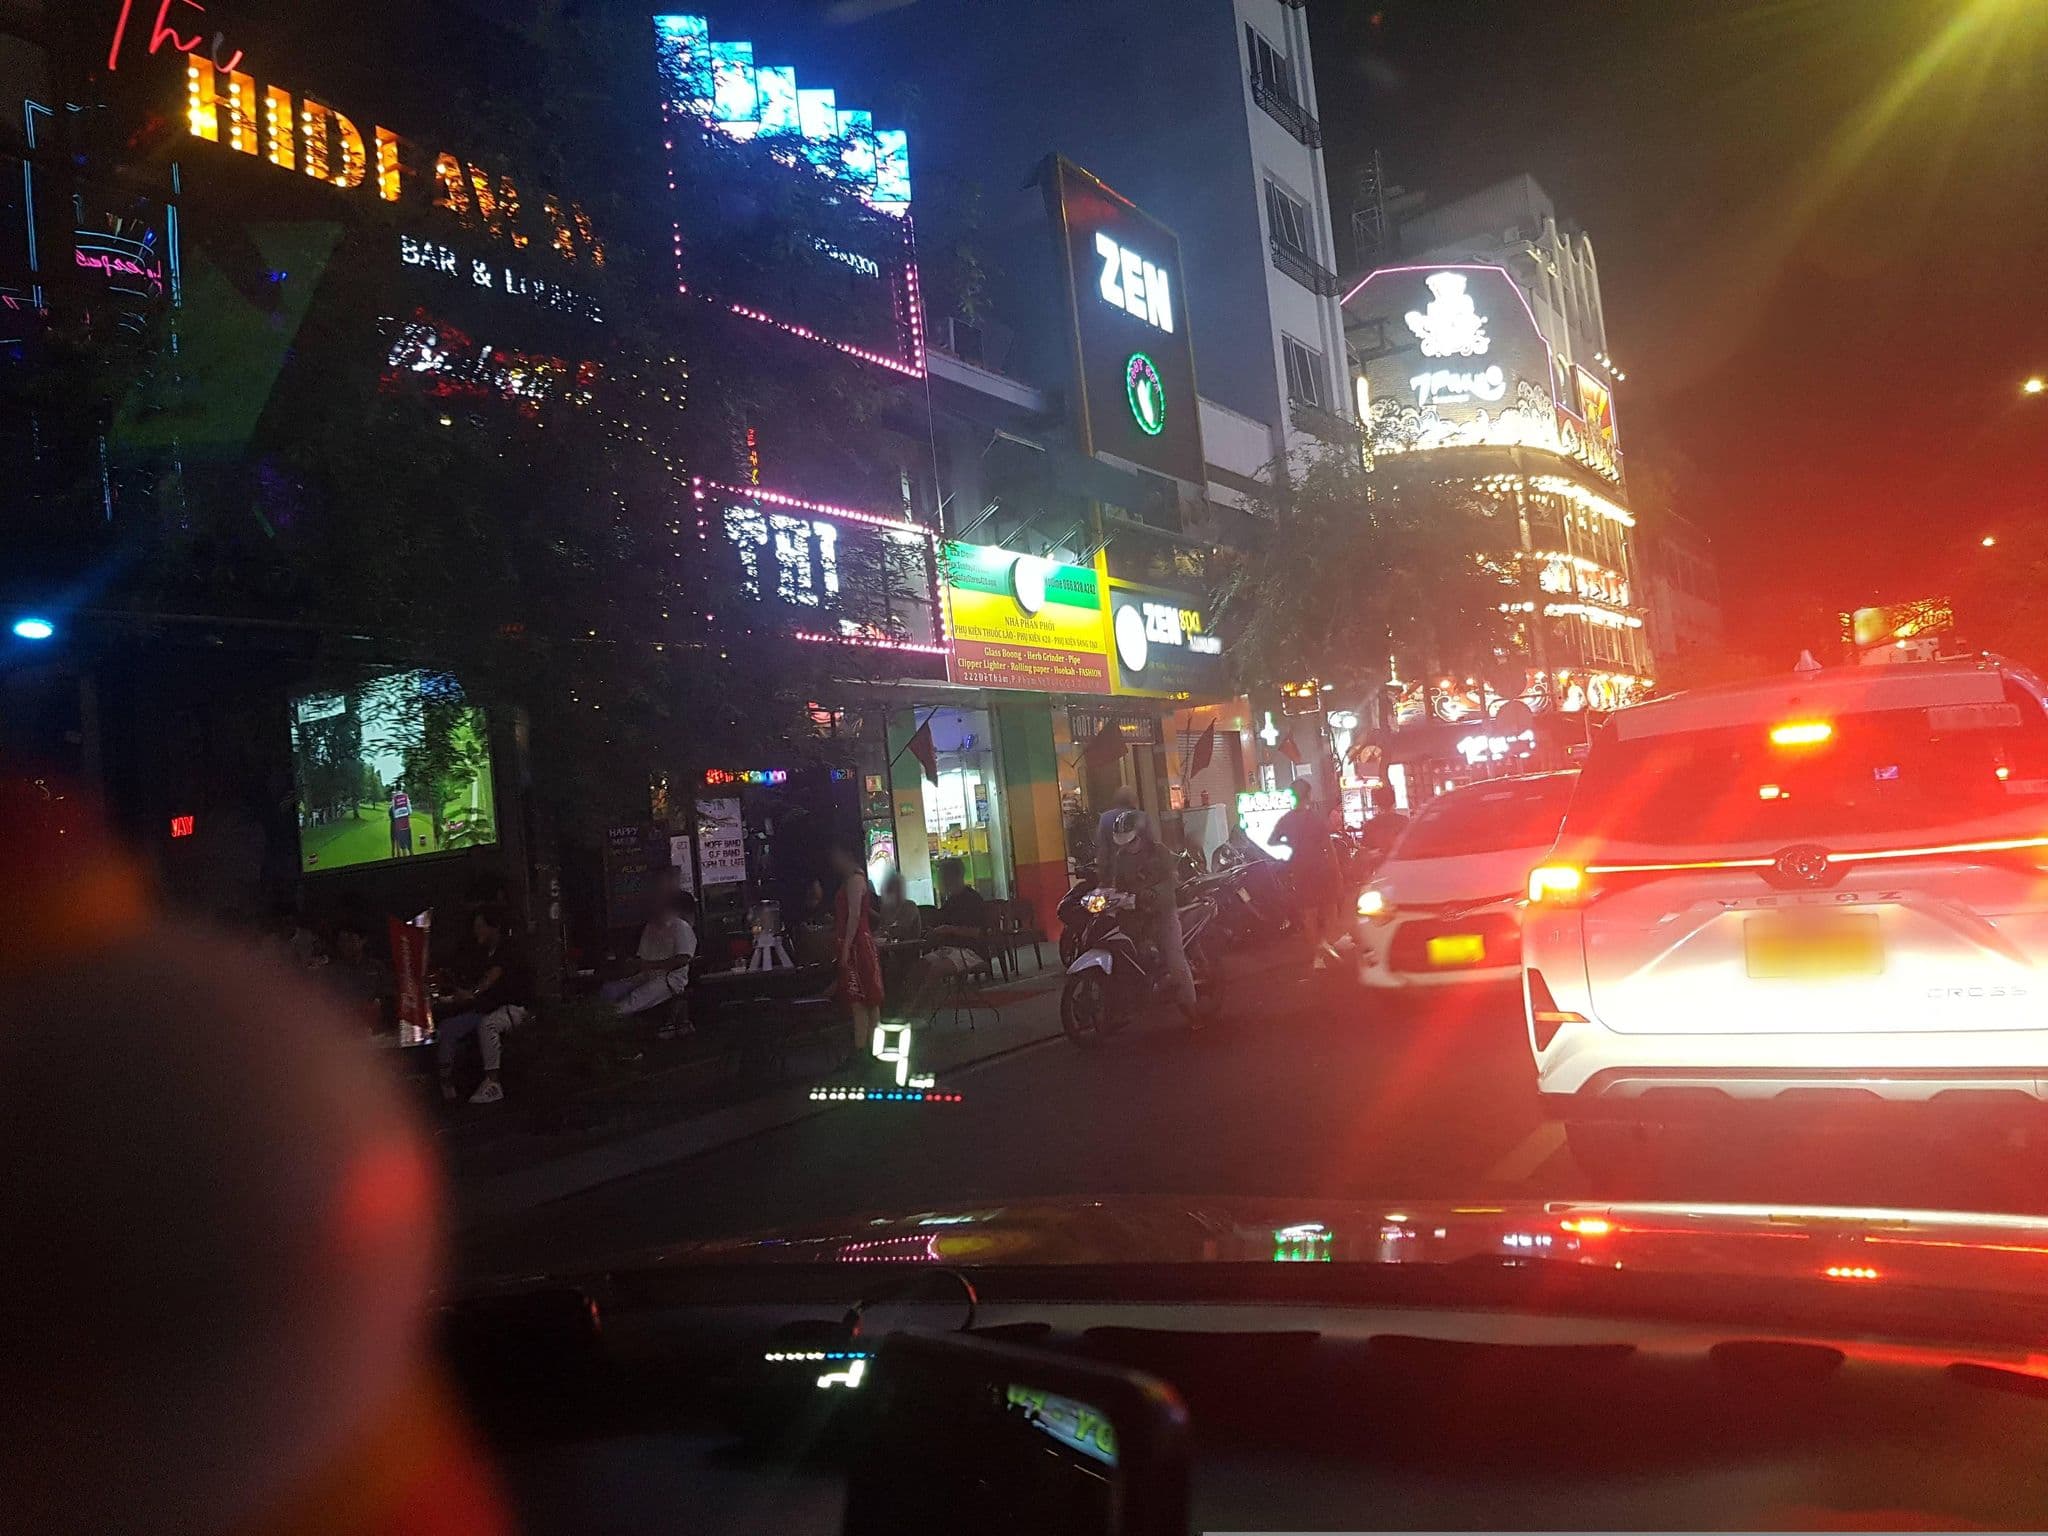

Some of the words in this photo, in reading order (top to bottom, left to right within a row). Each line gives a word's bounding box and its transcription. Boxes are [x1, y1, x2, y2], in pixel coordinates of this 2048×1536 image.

[401, 234, 459, 277] BAR
[1095, 230, 1174, 334] ZEN
[984, 647, 1001, 658] Glass
[1043, 652, 1065, 662] Grinder
[958, 657, 983, 669] Clipper
[984, 659, 1006, 671] Lighter
[1010, 662, 1032, 674] Rolling
[724, 838, 742, 848] BAND
[723, 849, 741, 858] BAND
[1717, 891, 1903, 909] VELOZ
[1926, 986, 2028, 999] CROSS
[872, 1021, 912, 1087] 9
